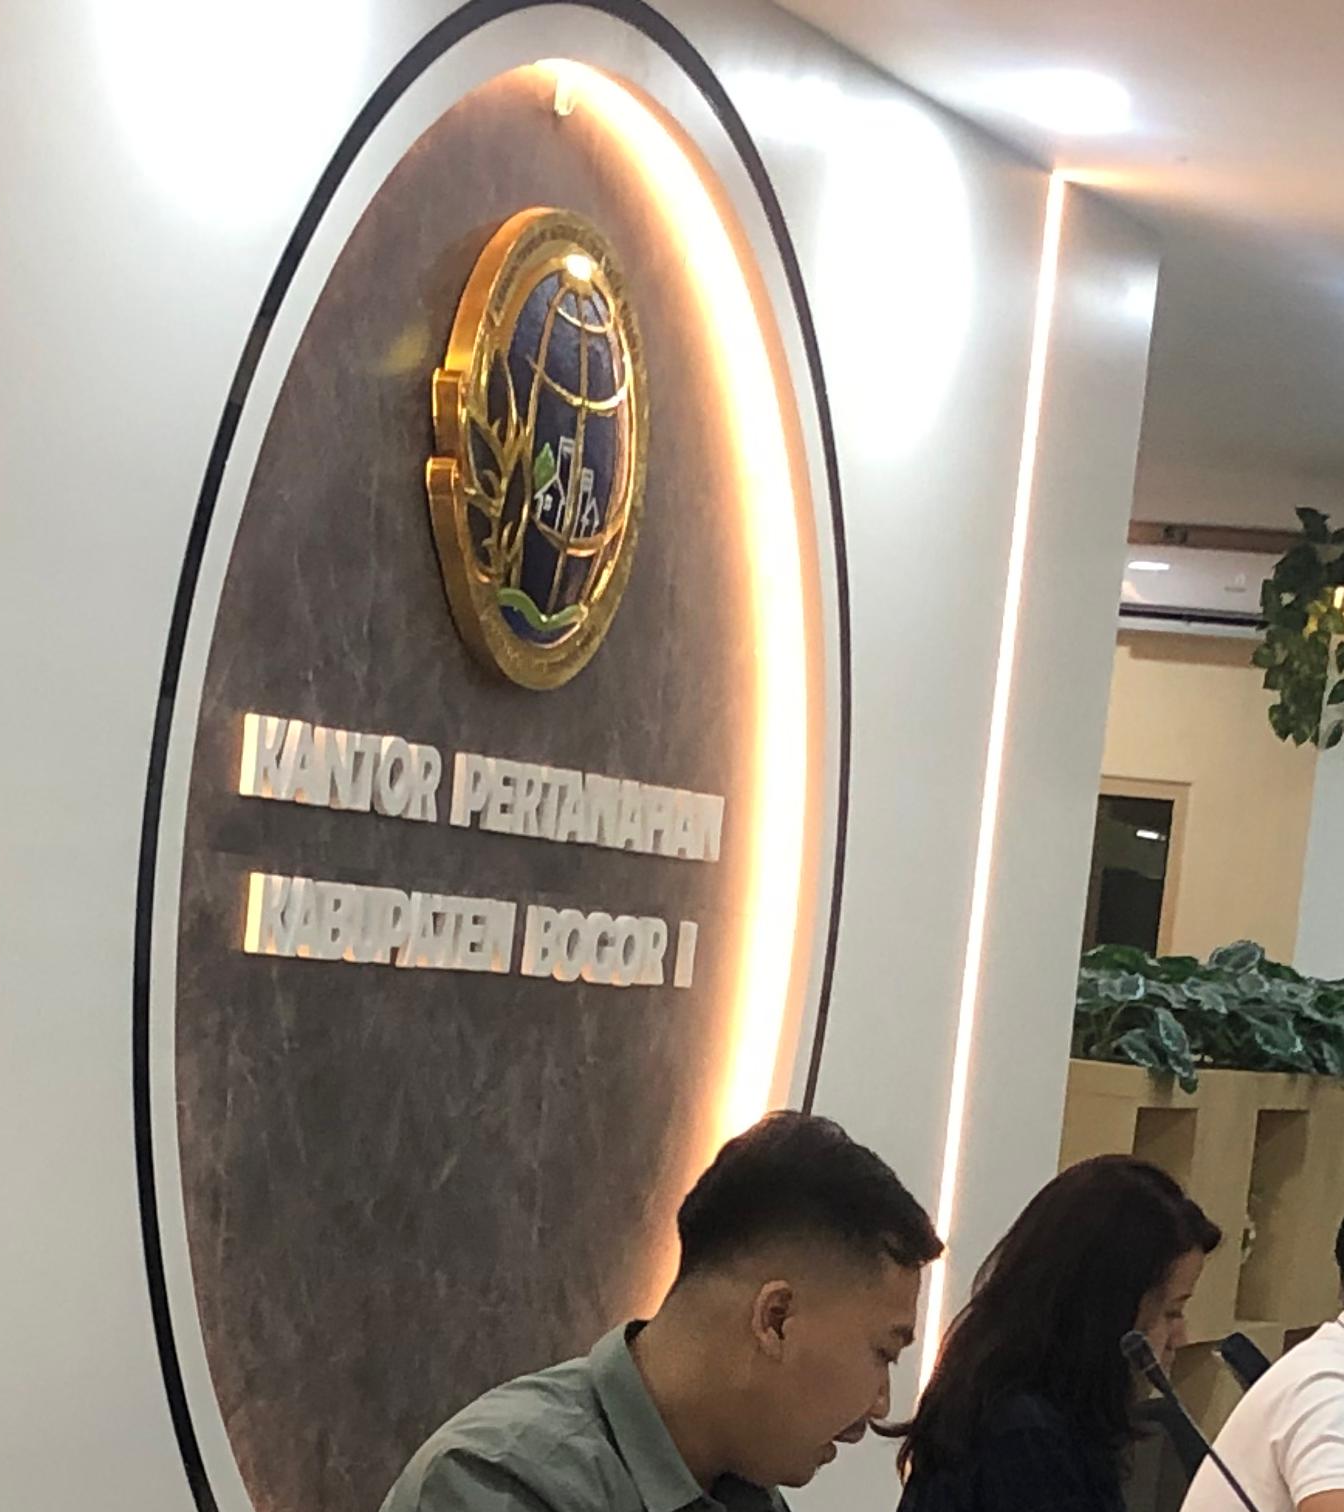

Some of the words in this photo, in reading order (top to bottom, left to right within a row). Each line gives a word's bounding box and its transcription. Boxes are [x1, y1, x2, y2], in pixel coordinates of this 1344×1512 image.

[239, 712, 442, 823] KANTOR
[450, 752, 725, 863] PERTANAHAN
[244, 871, 517, 974] KABUPATEN
[520, 904, 668, 988] BOGOR
[673, 920, 698, 988] I
